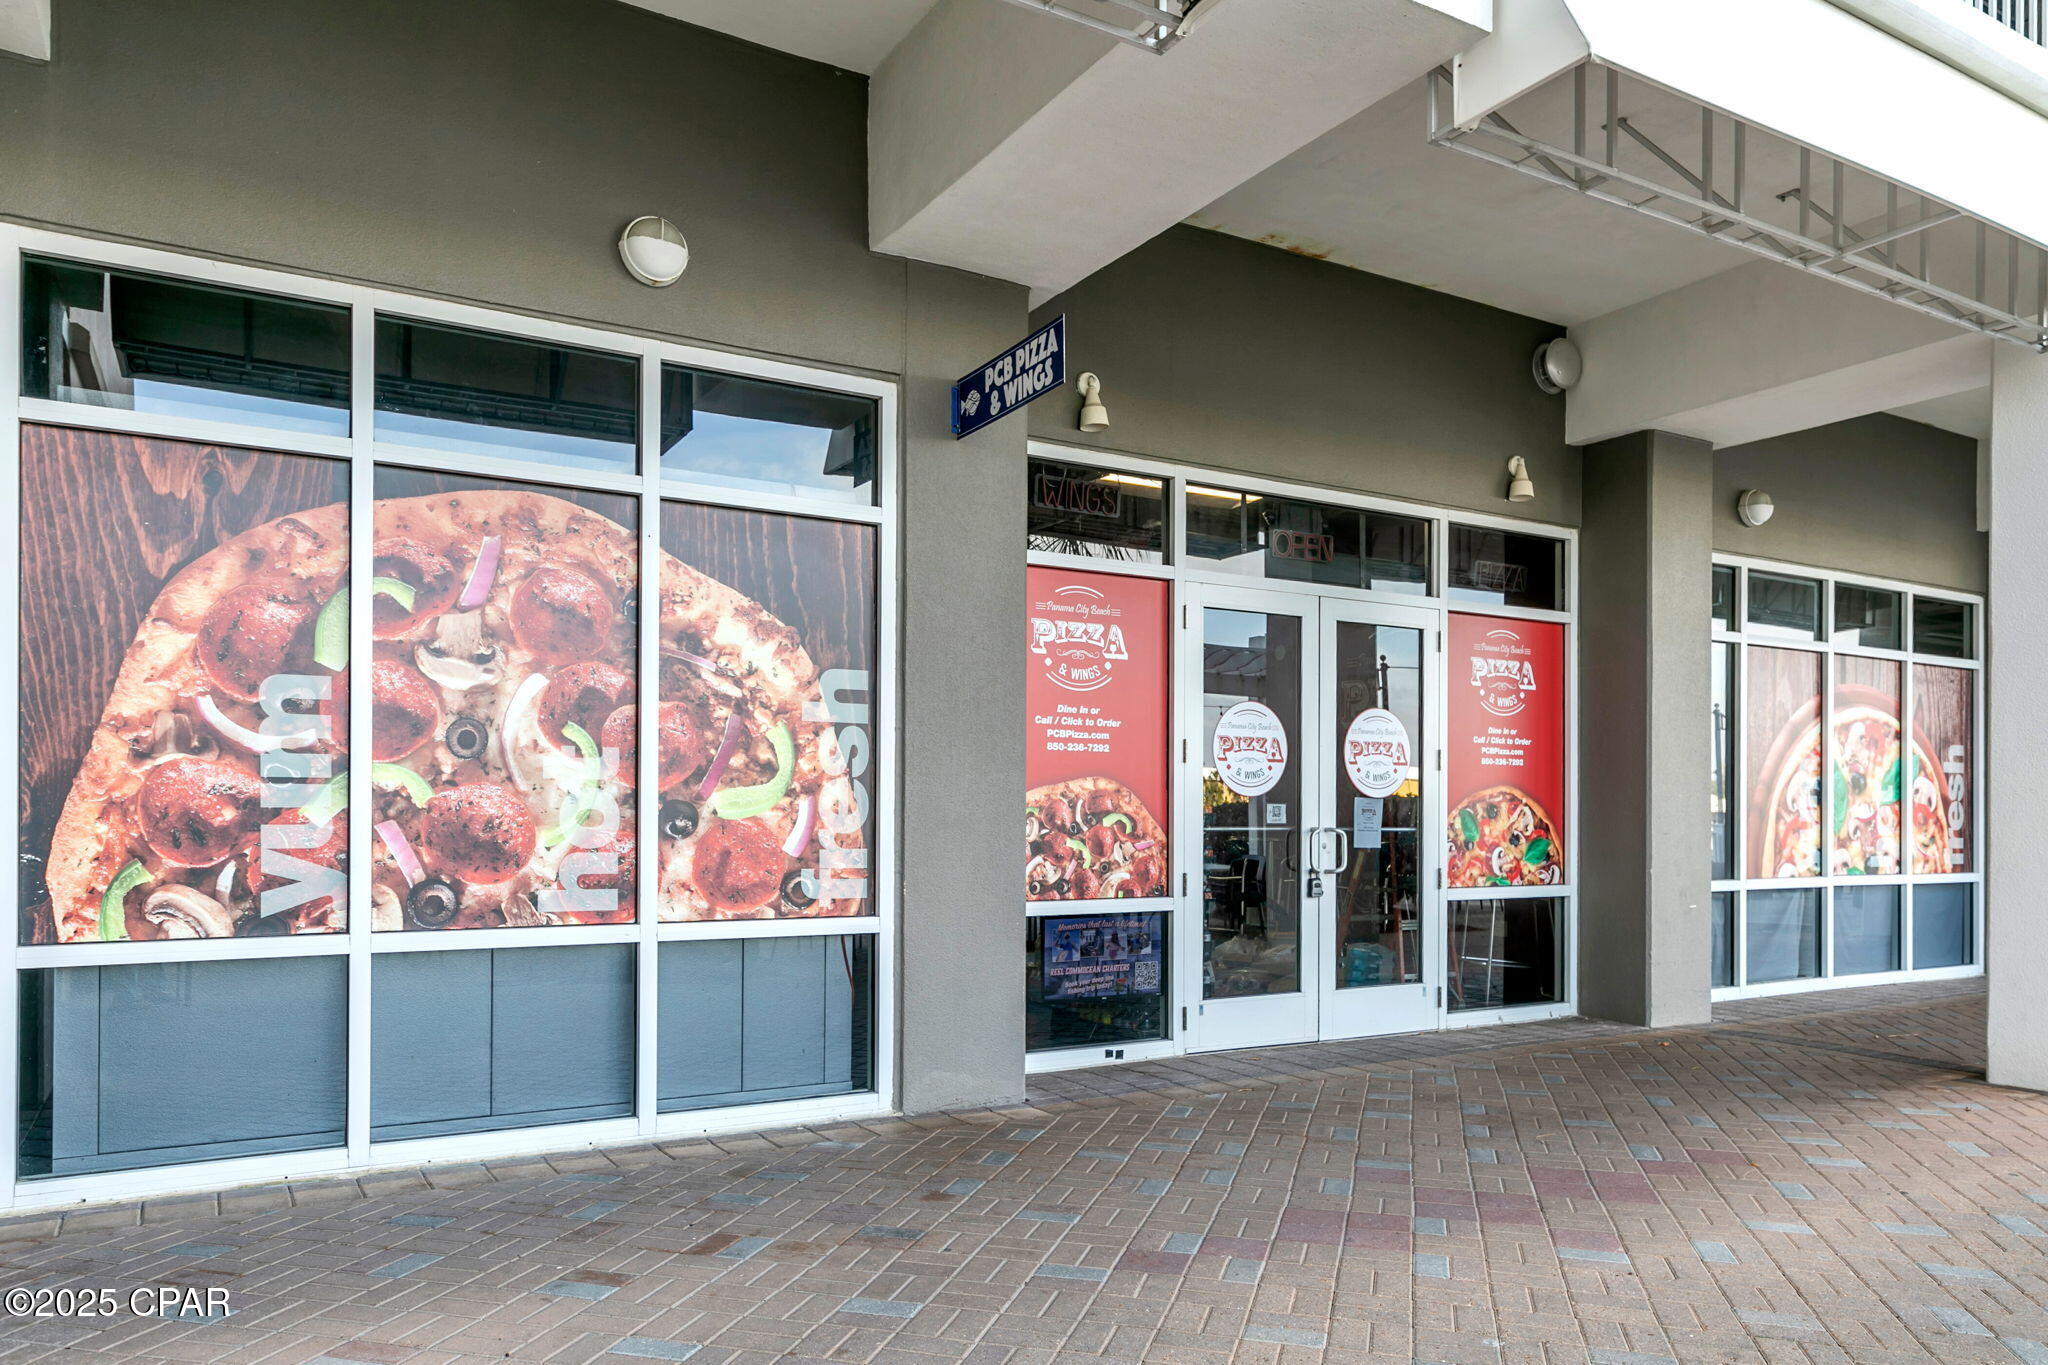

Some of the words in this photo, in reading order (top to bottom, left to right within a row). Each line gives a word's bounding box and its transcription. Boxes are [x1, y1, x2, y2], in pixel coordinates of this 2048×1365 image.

[985, 355, 1013, 393] PCB
[1015, 328, 1058, 375] PIZZA
[990, 390, 1001, 416] &
[1003, 357, 1054, 407] WINGS
[1043, 478, 1116, 515] WINGS
[1273, 529, 1334, 562] OPEN
[1046, 600, 1074, 613] Panama
[1075, 603, 1090, 619] City
[1091, 604, 1111, 616] Beach
[1030, 617, 1129, 660] PIZZA
[1059, 663, 1068, 677] &
[1071, 665, 1101, 681] WINGS
[1470, 656, 1537, 691] PIZZA
[1057, 704, 1078, 714] Dine
[1090, 707, 1101, 715] or
[1489, 692, 1495, 704] &
[1497, 694, 1518, 708] WINGS
[1035, 715, 1053, 725] Call
[1054, 716, 1059, 725] /
[1061, 716, 1083, 726] Click
[1085, 717, 1095, 726] to
[1096, 718, 1122, 728] Order
[1248, 722, 1257, 734] City
[1488, 726, 1502, 735] Dine
[1046, 728, 1110, 740] PCBPizza.com
[1473, 735, 1486, 744] Call
[1490, 736, 1506, 745] Click
[1507, 737, 1514, 745] to
[1514, 738, 1532, 746] Order
[1216, 734, 1284, 763] PIZZA
[1348, 739, 1408, 766] PIZZA
[1236, 767, 1242, 777] &
[1244, 767, 1265, 780] WINGS
[1365, 770, 1370, 780] &
[1372, 770, 1391, 782] WINGS
[258, 673, 348, 919] yum
[800, 668, 870, 908] fresh
[537, 745, 621, 913] hot
[1102, 963, 1130, 973] CHARTERS
